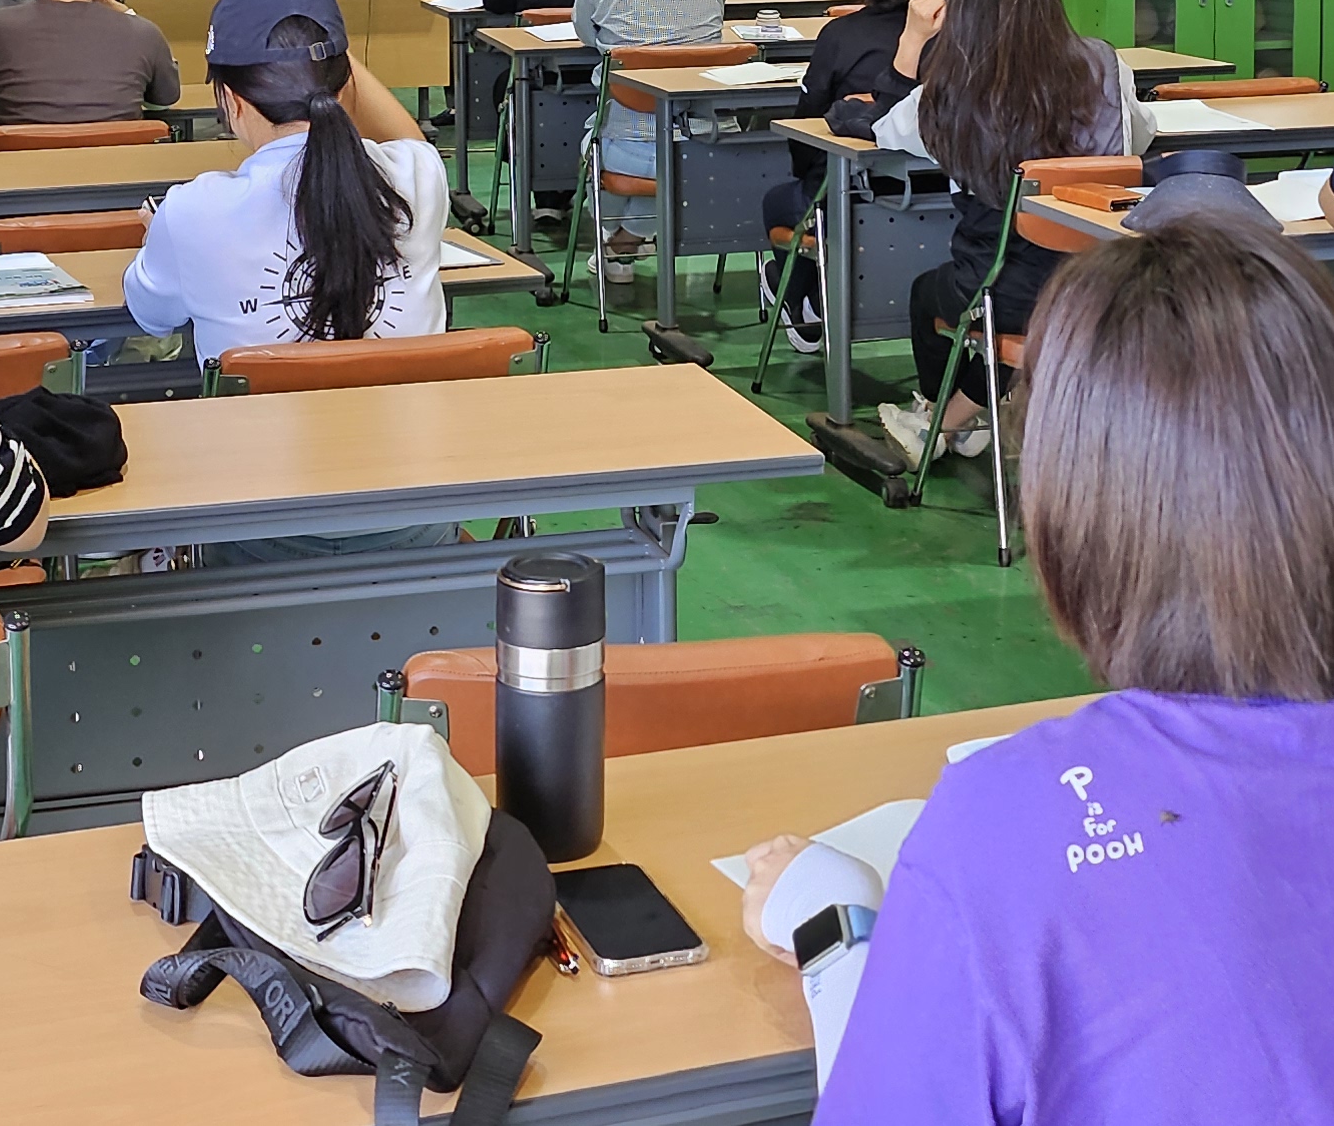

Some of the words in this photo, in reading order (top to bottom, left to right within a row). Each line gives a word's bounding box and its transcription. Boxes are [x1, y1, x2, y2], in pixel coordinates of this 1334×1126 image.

[403, 264, 413, 280] E
[239, 298, 259, 315] W
[1059, 765, 1094, 802] P
[1066, 831, 1145, 874] POOH
